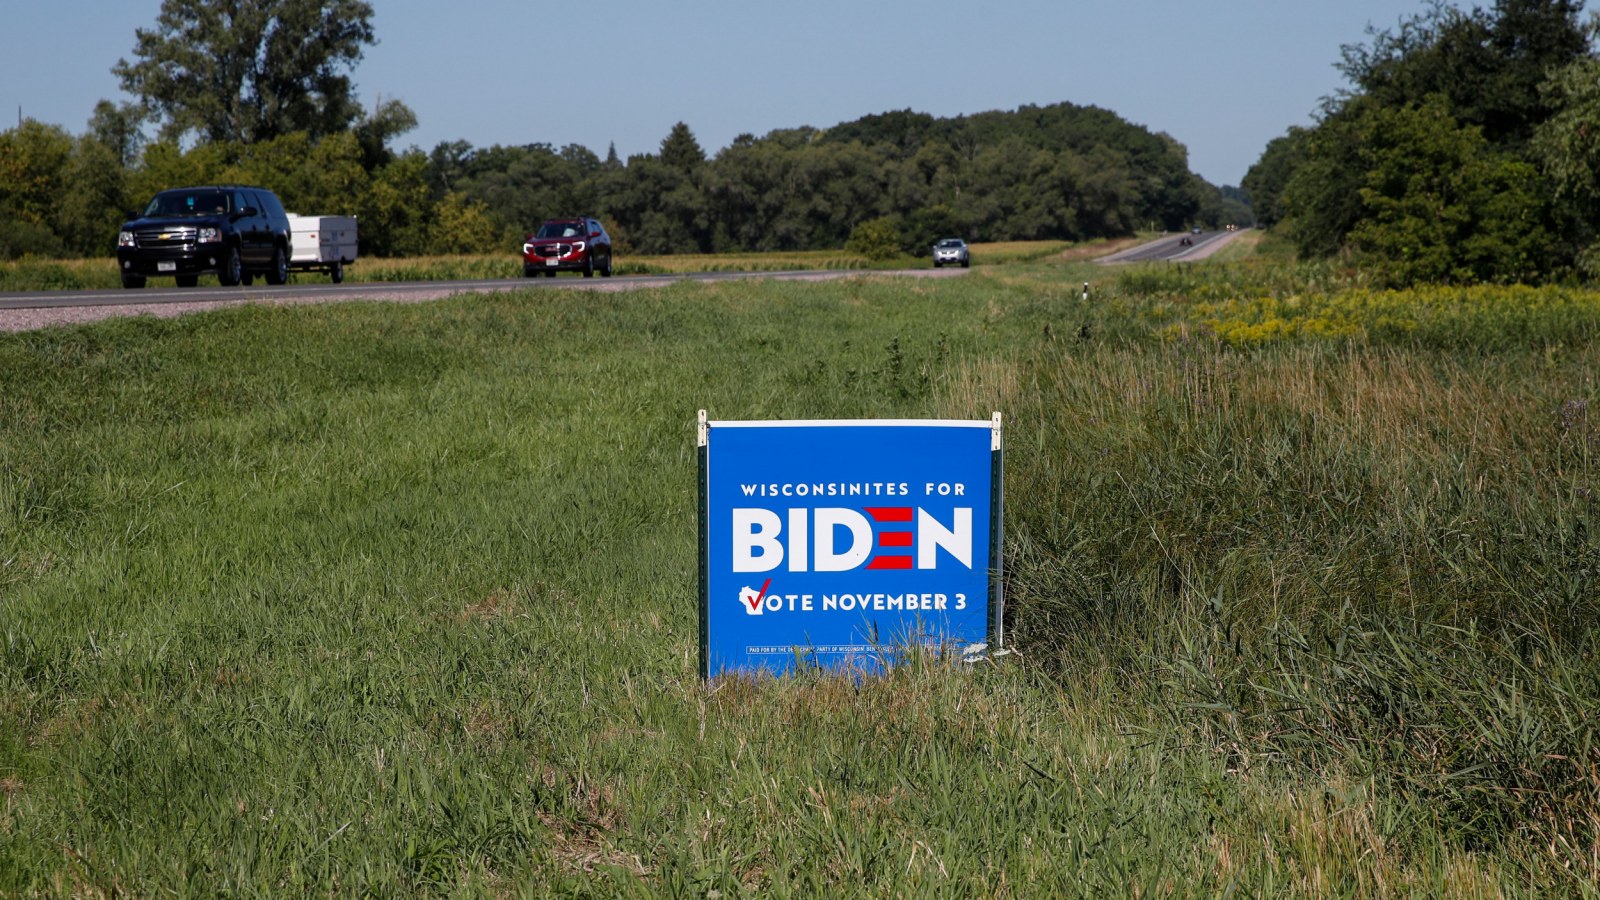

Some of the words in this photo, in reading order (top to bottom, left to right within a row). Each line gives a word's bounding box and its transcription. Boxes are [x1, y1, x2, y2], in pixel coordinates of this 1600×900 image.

[740, 482, 909, 497] WISCONSINITES
[925, 482, 966, 496] FOR
[732, 506, 973, 573] BIDEN
[746, 578, 814, 612] VOTE
[822, 593, 948, 611] NOVEMBER
[955, 594, 968, 611] 3
